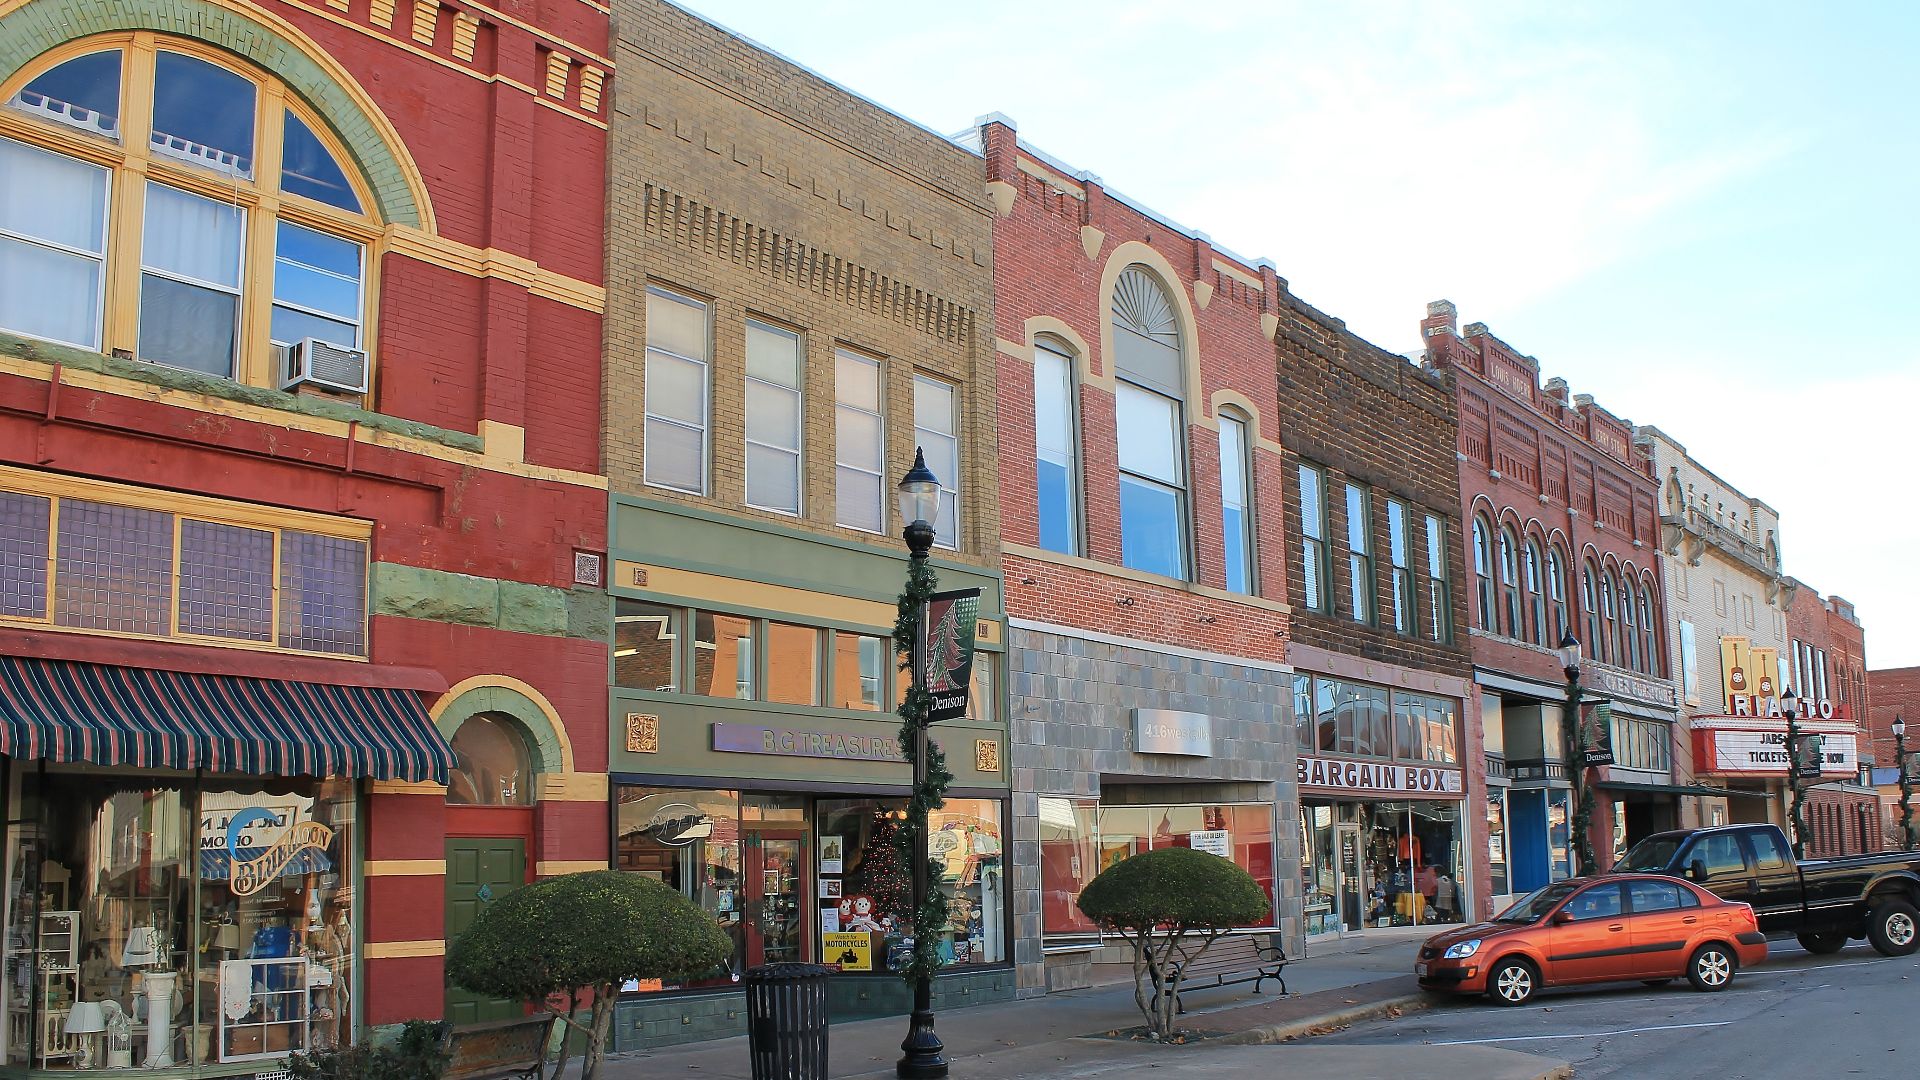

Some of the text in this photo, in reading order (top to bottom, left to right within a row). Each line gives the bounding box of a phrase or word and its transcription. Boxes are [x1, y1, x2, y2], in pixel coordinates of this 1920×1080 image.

[931, 694, 965, 711] Denison
[1734, 695, 1833, 719] RIATO
[799, 732, 904, 758] TREASURES
[1586, 753, 1612, 762] Denison
[1749, 751, 1788, 763] TICKETS
[1827, 753, 1844, 764] NOW
[1297, 759, 1396, 788] BARGAIN
[1405, 768, 1446, 791] BOX
[234, 826, 328, 893] BLUE MOON
[825, 940, 868, 948] MOTORCYCLES
